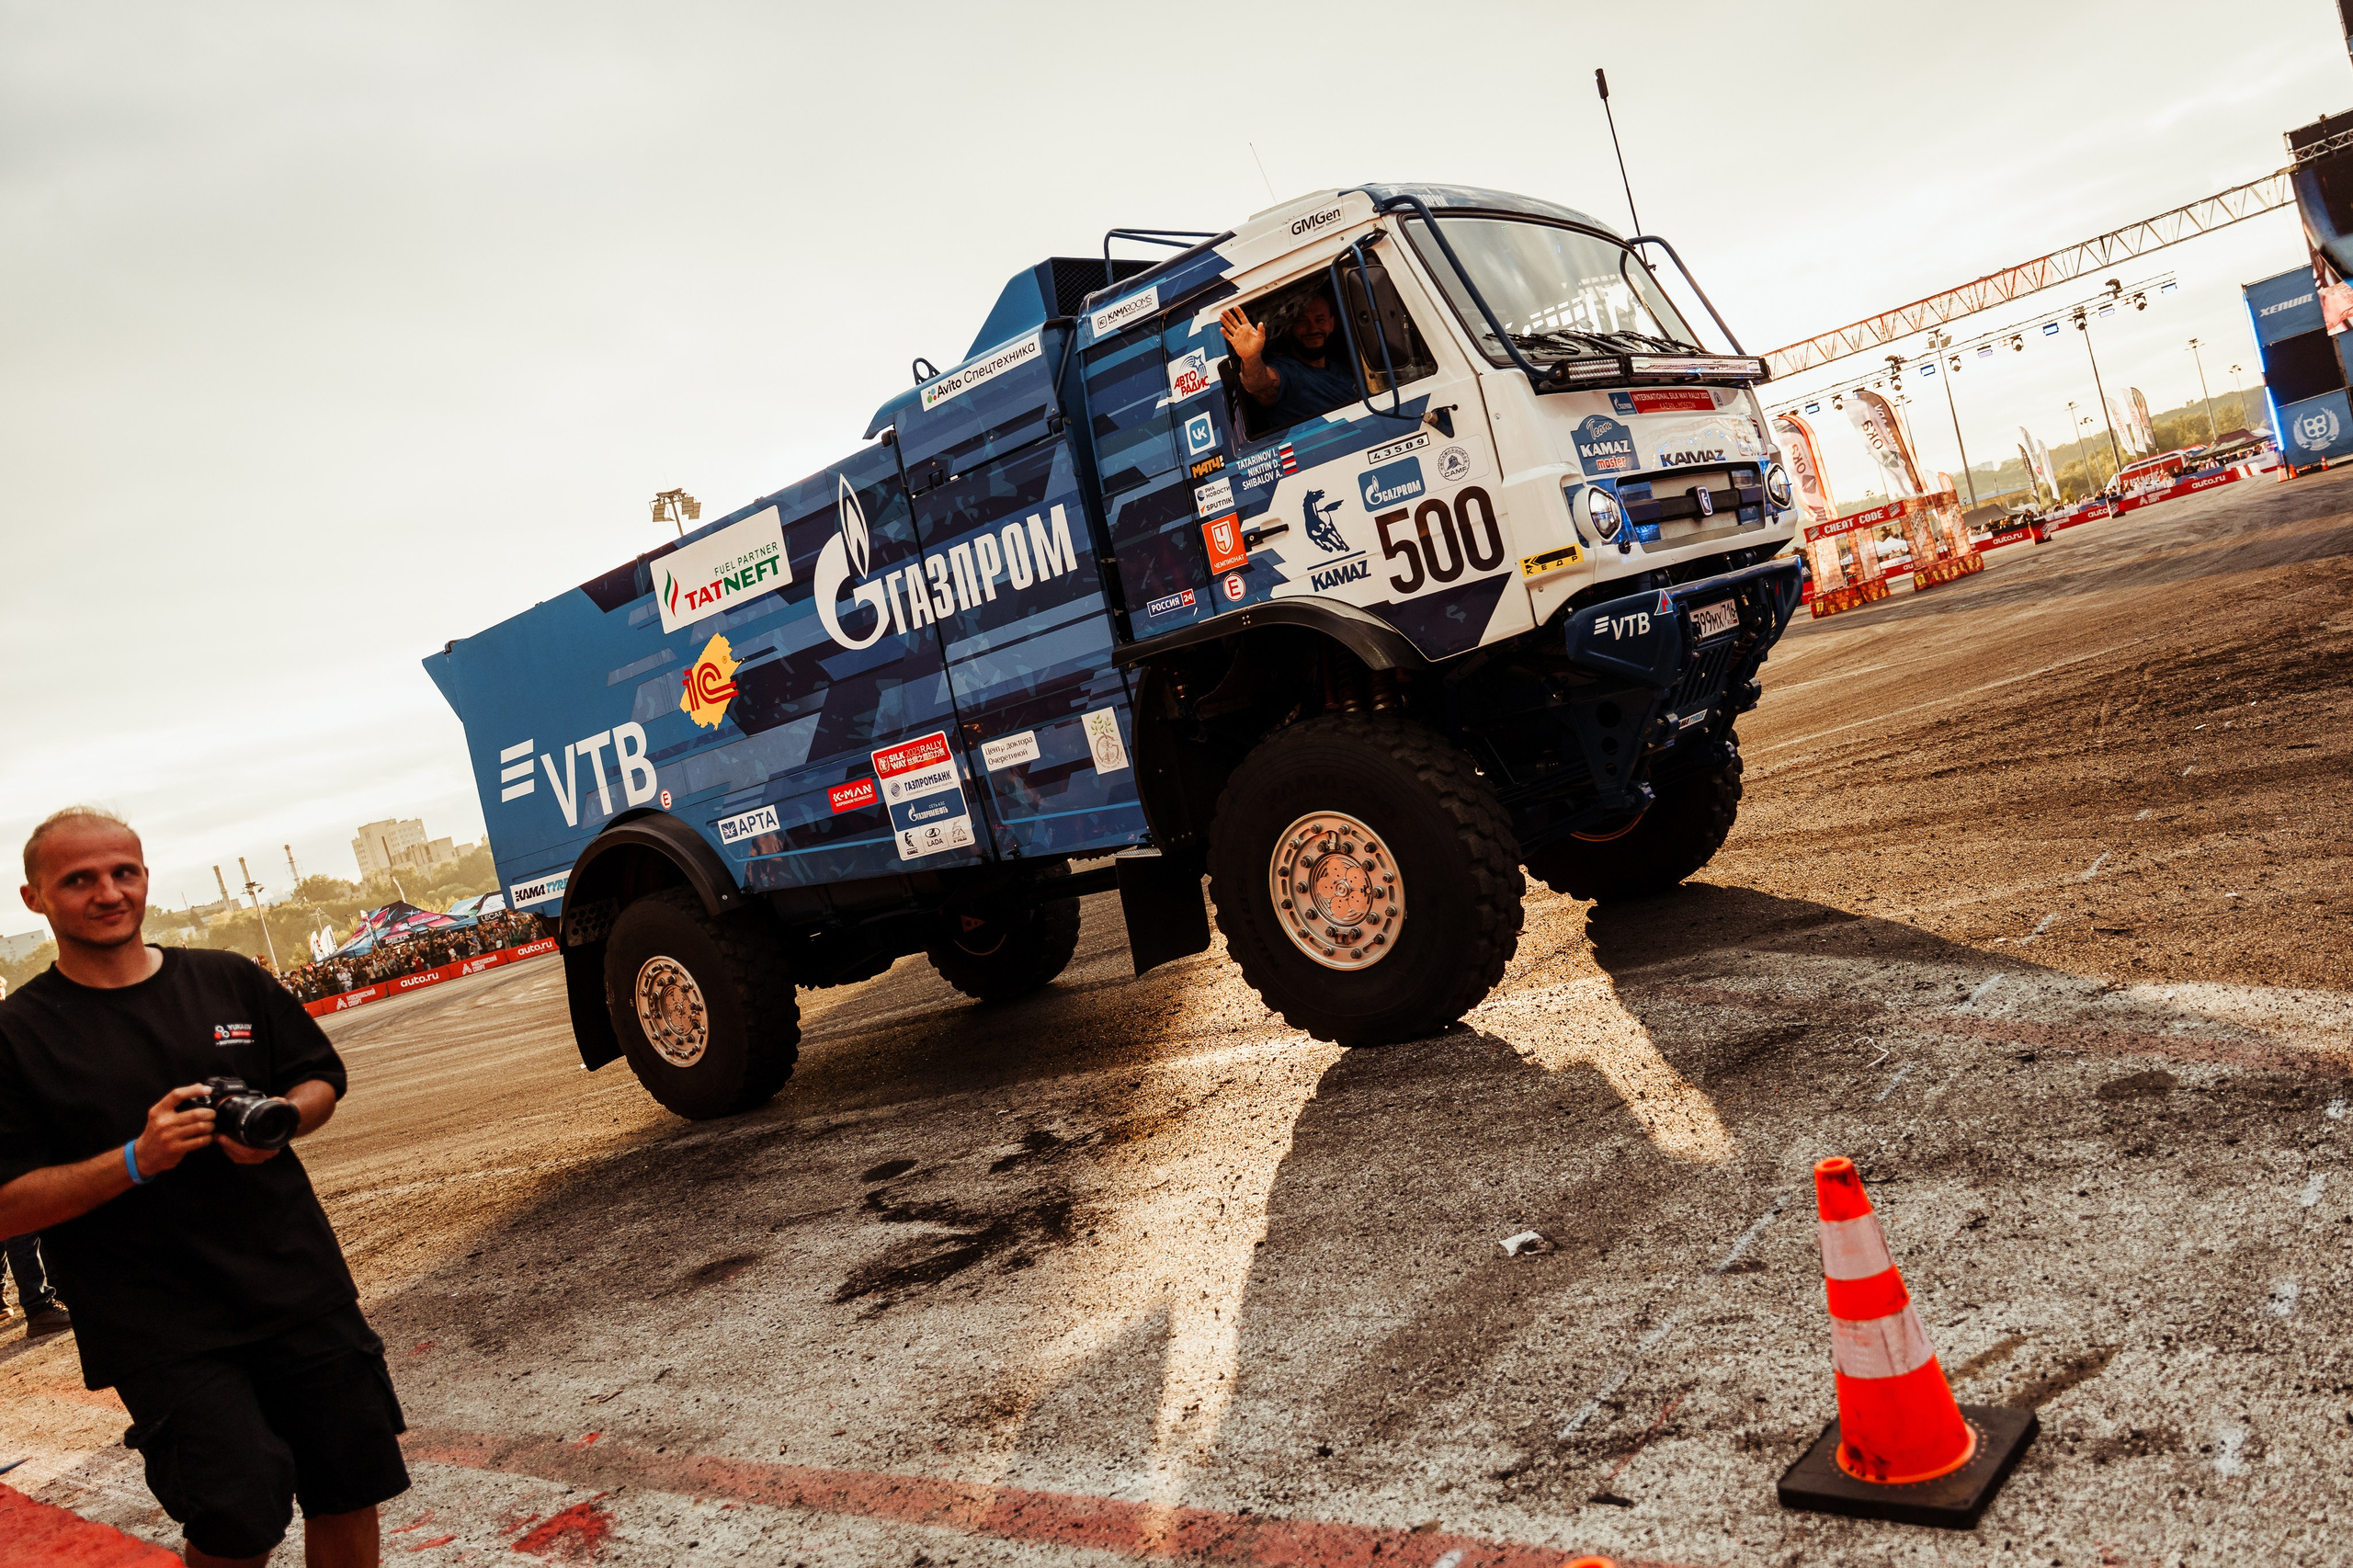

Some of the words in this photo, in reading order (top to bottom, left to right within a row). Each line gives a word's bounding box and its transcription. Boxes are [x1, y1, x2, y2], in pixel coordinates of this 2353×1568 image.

[1290, 208, 1341, 236] GMGen
[1107, 294, 1153, 321] KAMAROOMS
[938, 379, 962, 398] Avito
[963, 342, 1036, 383] Спецтехника
[1174, 370, 1197, 390] АВТО
[1192, 426, 1208, 440] VK
[1586, 418, 1612, 440] Team
[1580, 439, 1631, 458] KAMAZ
[1660, 449, 1726, 467] KAMAZ
[1191, 455, 1225, 478] МАТЧ!
[1236, 449, 1271, 470] TATARINOV
[1272, 449, 1278, 457] I.
[1247, 461, 1272, 477] NIKITIN
[1272, 459, 1280, 469] D.
[1596, 455, 1626, 471] master
[1242, 472, 1274, 490] SHIBALOV
[1276, 469, 1283, 479] A.
[1444, 466, 1467, 477] CAMF
[2191, 474, 2225, 489] auto.ru
[1206, 485, 1230, 498] НОВОСТИ
[1381, 479, 1422, 503] GAZPROM
[1206, 496, 1233, 511] SPUTNIK
[1824, 518, 1854, 534] CHEAT
[1859, 510, 1885, 524] CODE
[1374, 485, 1505, 594] 500
[1993, 532, 2023, 545] auto.ru
[714, 560, 735, 576] FUEL
[737, 541, 779, 567] PARTNER
[1213, 553, 1245, 569] ЧЕМПИОНАТ
[1526, 555, 1578, 575] КЕДР
[885, 503, 1078, 635] ГАЗПРОМ
[1311, 559, 1371, 592] KAMAZ
[684, 554, 780, 611] TATNEFT
[1228, 578, 1241, 597] E
[1151, 597, 1180, 613] РОССИЯ
[1183, 593, 1193, 602] 24
[1610, 612, 1651, 641] VTB
[889, 751, 905, 763] SILK
[904, 746, 920, 758] 2023
[919, 740, 942, 754] RALLY
[984, 744, 1006, 756] Центр
[1006, 736, 1033, 751] доктора
[891, 759, 907, 770] WAY
[987, 749, 1029, 766] Очеретиной
[540, 722, 657, 827] VTB
[904, 770, 952, 791] ГАЗПРОМБАНК
[662, 791, 670, 806] E
[832, 784, 872, 802] K-MAN
[739, 811, 777, 835] АРТА
[926, 838, 944, 847] LADA
[515, 884, 546, 902] KAMA
[517, 939, 552, 957] auto.ru
[400, 971, 439, 989] auto.ru
